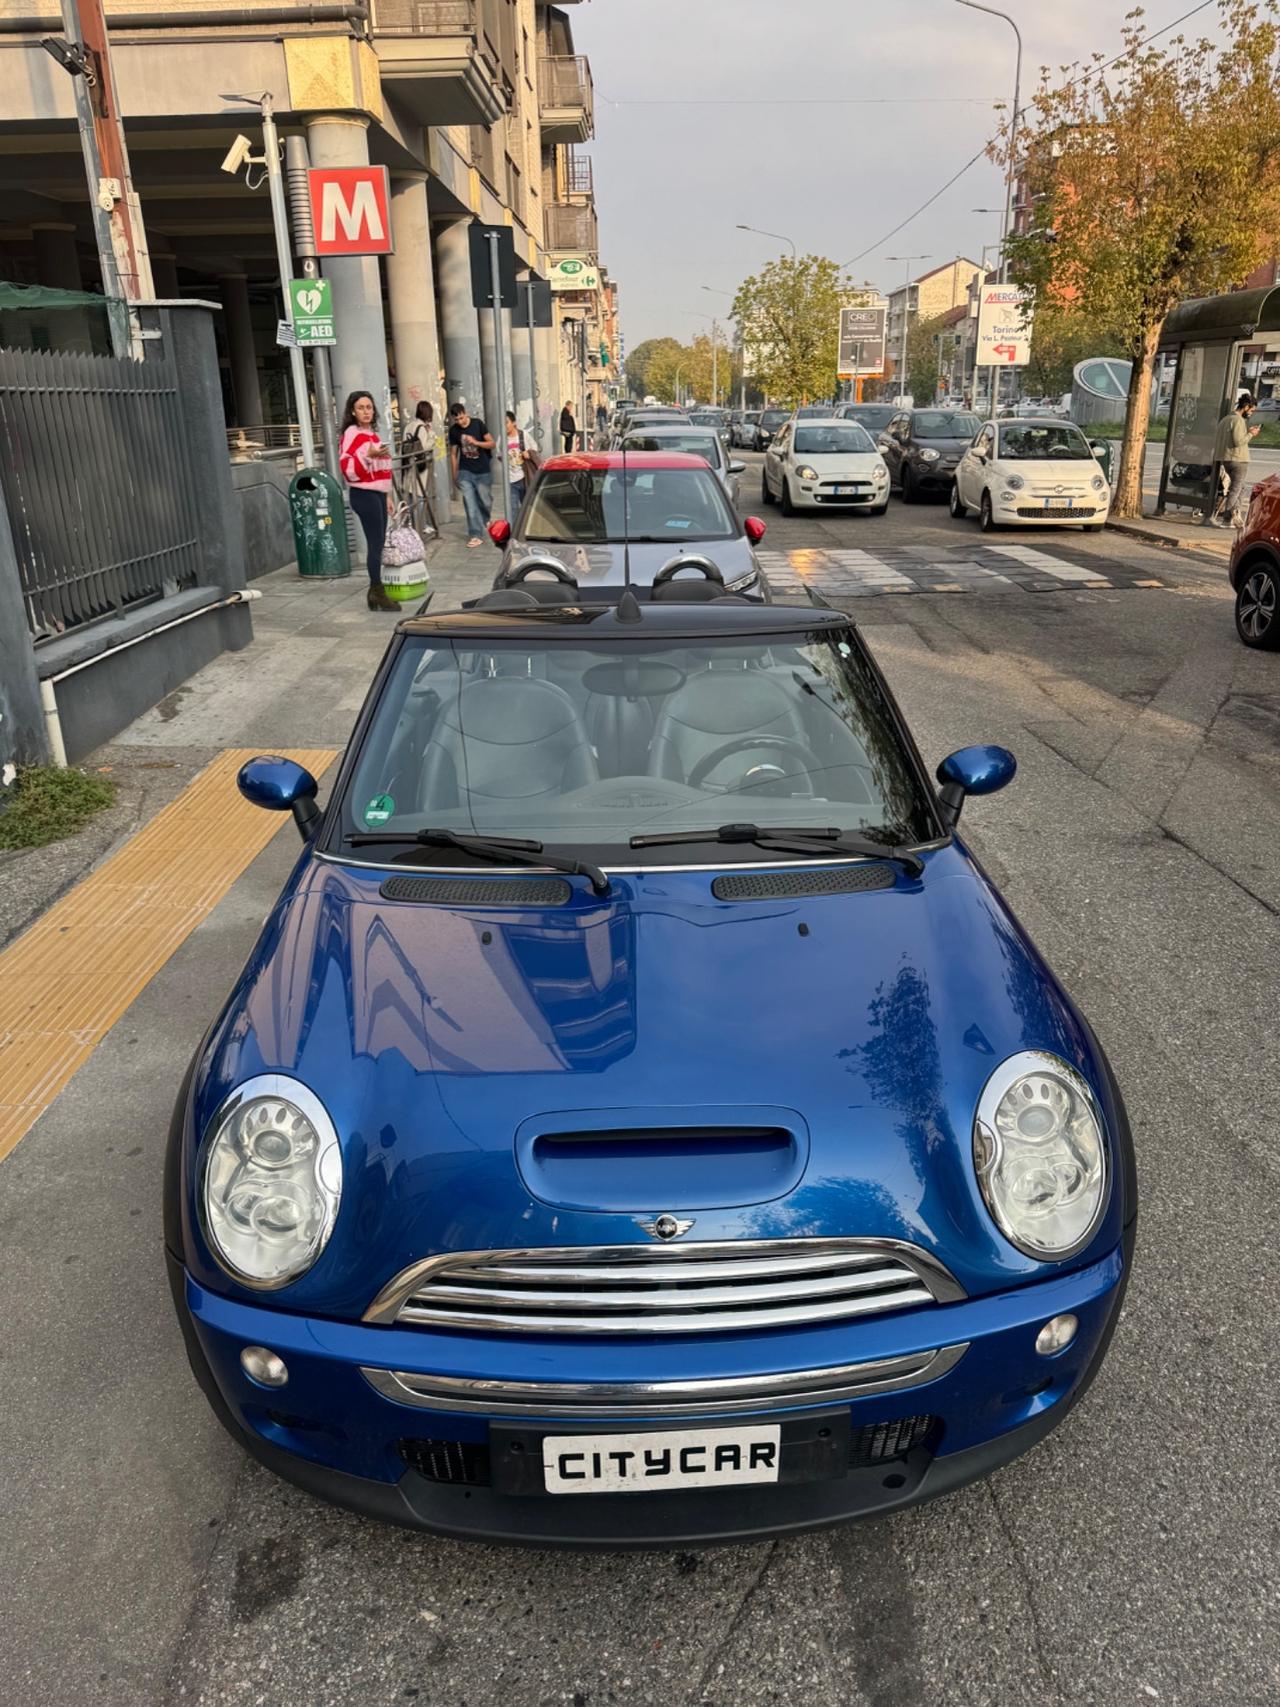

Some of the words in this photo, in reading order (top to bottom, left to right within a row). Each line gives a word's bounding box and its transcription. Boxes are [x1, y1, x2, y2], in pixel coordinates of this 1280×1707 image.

[321, 181, 385, 242] M
[310, 325, 333, 337] AED
[993, 326, 1020, 334] Torino
[376, 796, 386, 810] 4
[558, 1442, 776, 1479] CITYCAR
